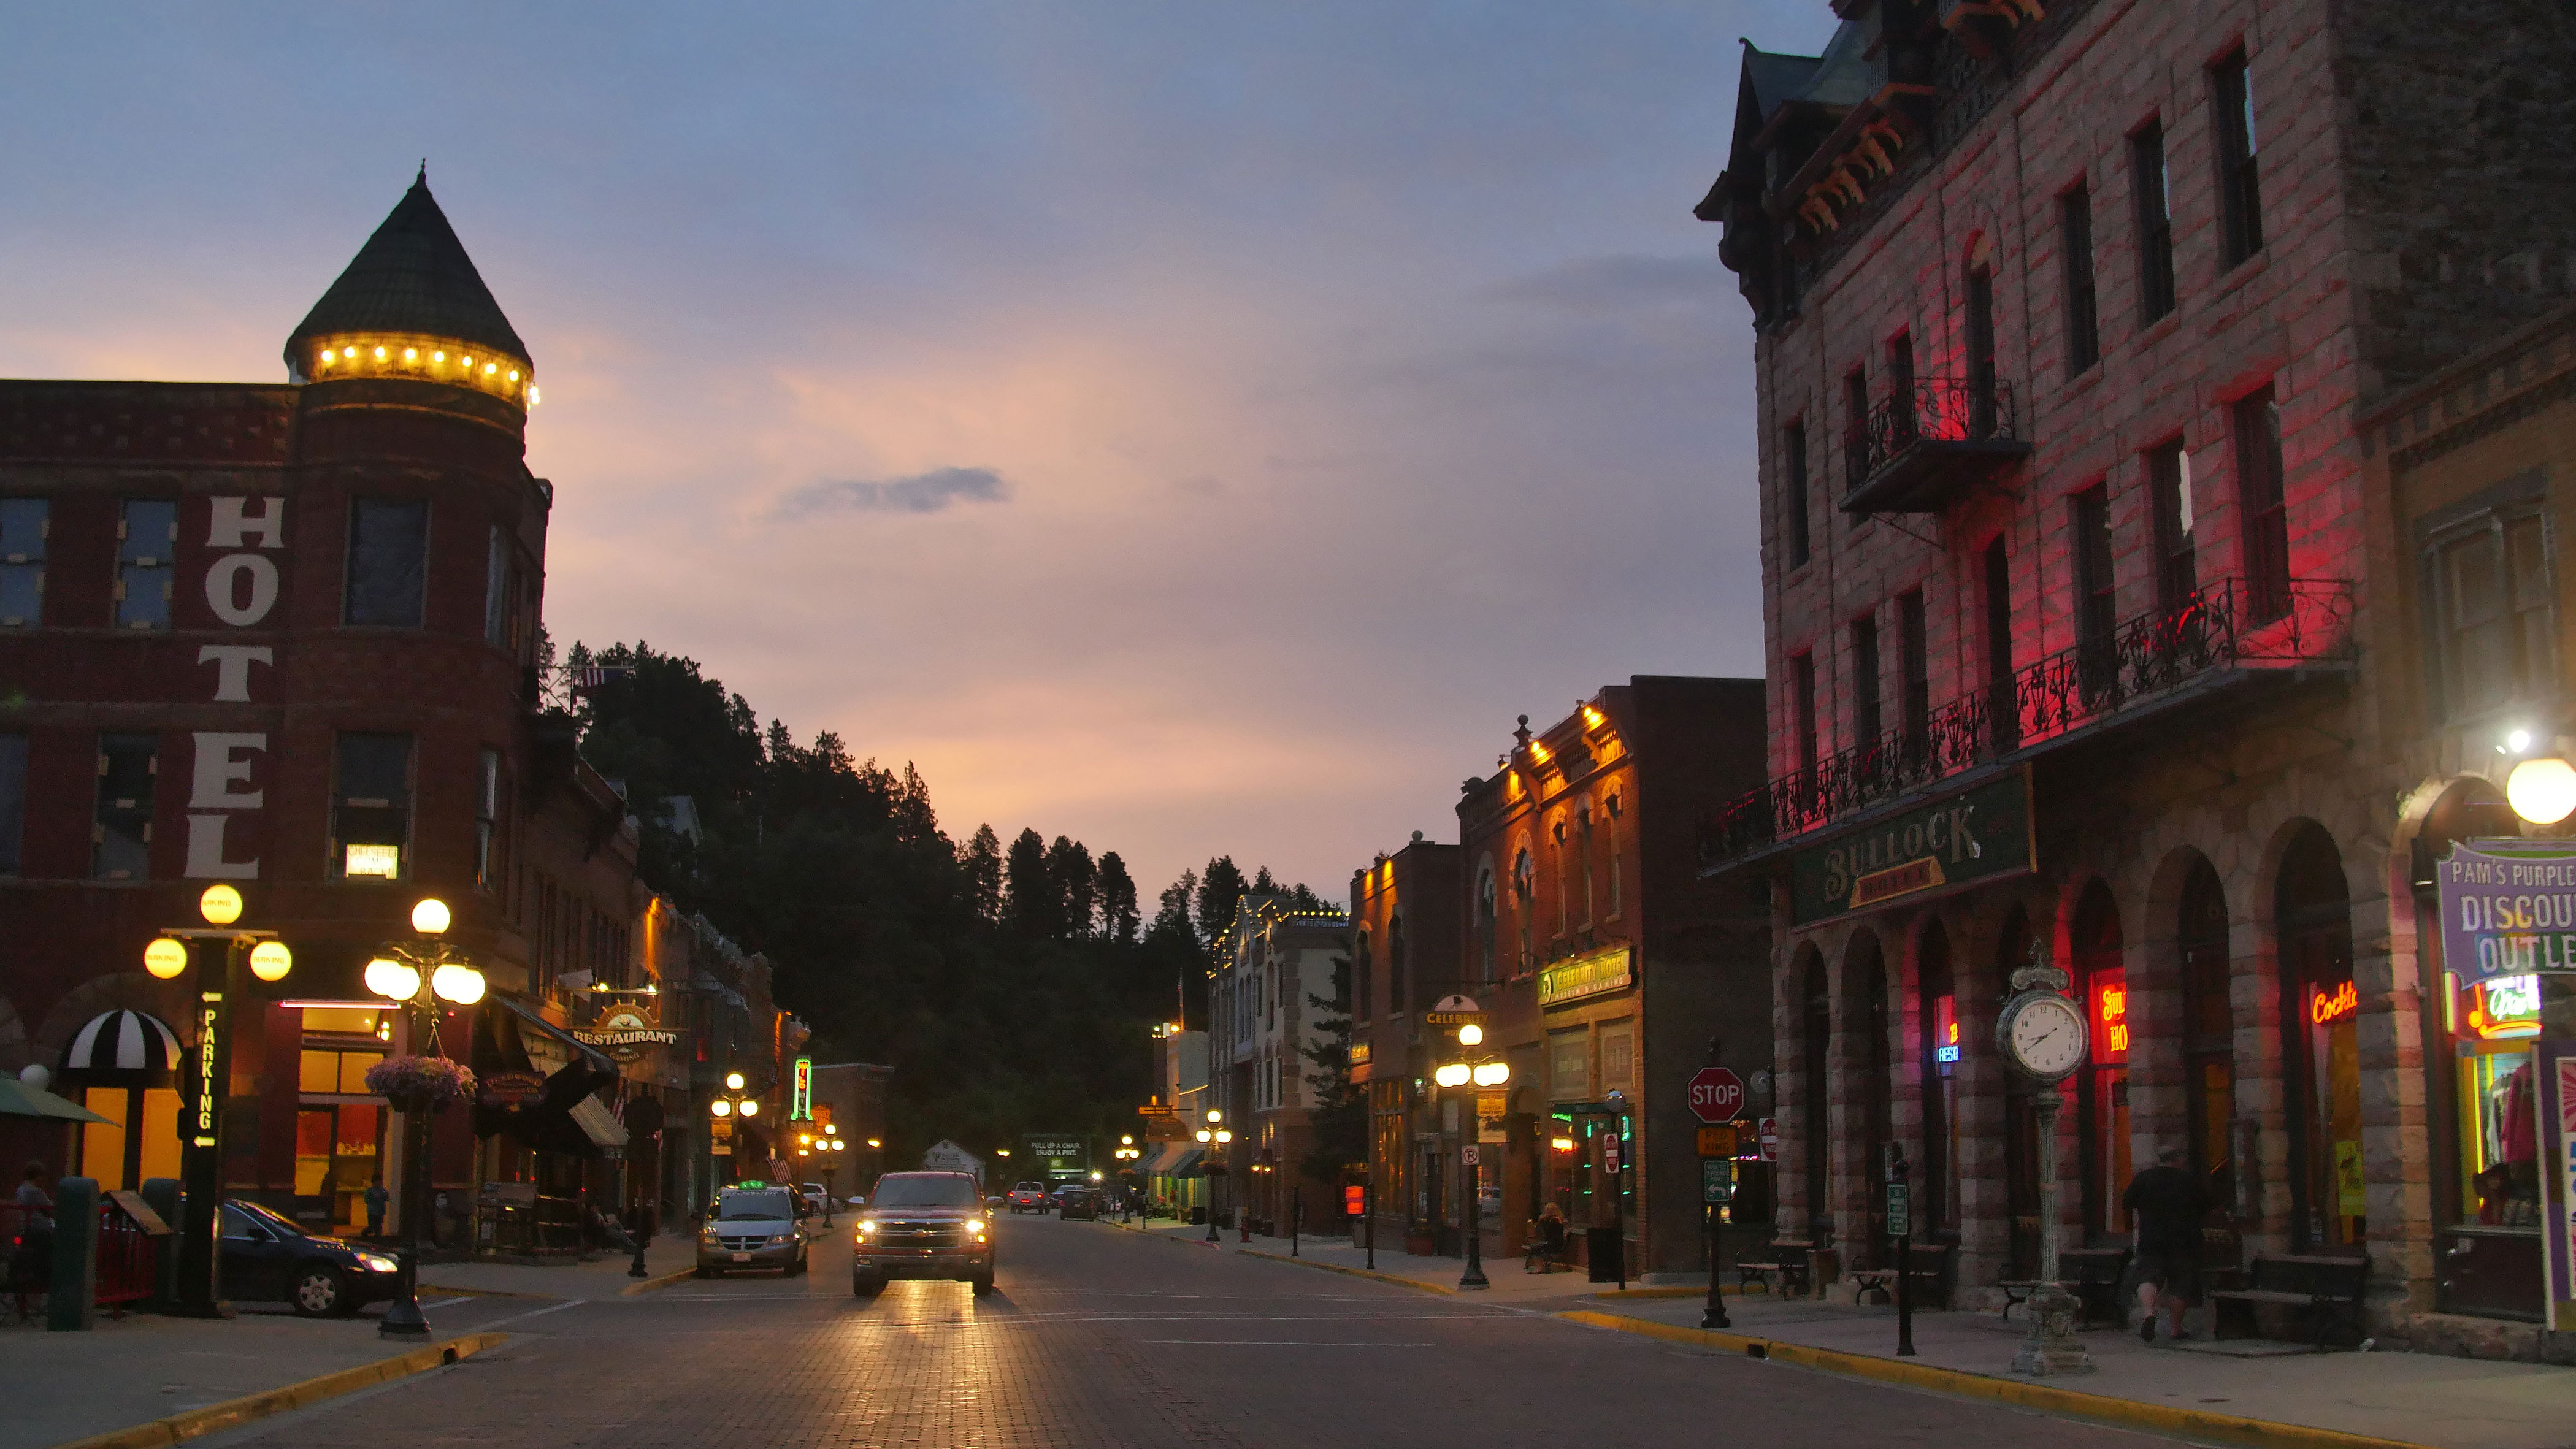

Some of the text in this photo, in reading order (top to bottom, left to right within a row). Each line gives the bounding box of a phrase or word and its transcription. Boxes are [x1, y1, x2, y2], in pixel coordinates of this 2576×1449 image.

[183, 495, 286, 879] HOTEL
[1824, 805, 1981, 903] BULLOCK
[2452, 860, 2576, 887] PAM'S PURPLE
[2460, 893, 2576, 932] DISCOU
[1557, 955, 1625, 990] CELEBRITY HOTEL
[1425, 1012, 1489, 1025] CELEBRITY
[2103, 990, 2126, 1021] BUL
[573, 1030, 677, 1046] RESTAURANT
[199, 1009, 217, 1130] PARKING
[1692, 1085, 1739, 1105] STOP
